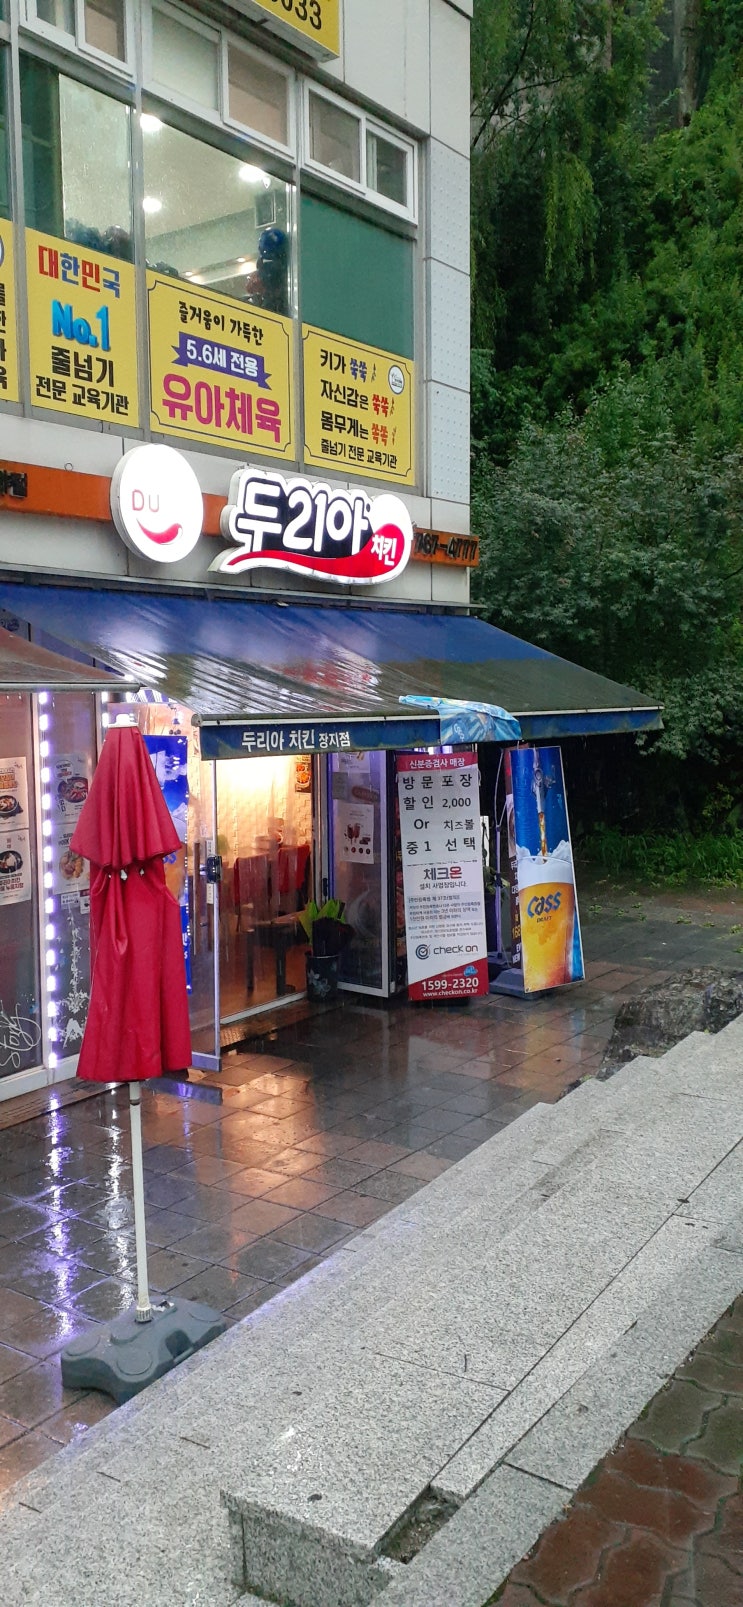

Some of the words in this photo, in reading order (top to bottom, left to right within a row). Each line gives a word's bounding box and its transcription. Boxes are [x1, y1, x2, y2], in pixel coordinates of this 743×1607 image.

[38, 245, 120, 298] 대한민국
[51, 299, 111, 352] No.1
[178, 300, 225, 331] 즐거움이
[230, 319, 264, 346] 가득한
[51, 346, 115, 388] 줄넘기
[186, 339, 226, 369] 5.6세
[230, 352, 258, 378] 전용
[320, 349, 346, 374] 키가
[35, 375, 67, 403] 전문
[72, 383, 129, 416] 교육기관
[162, 373, 282, 443] 유아체육
[320, 379, 369, 411] 자신감은
[321, 410, 369, 440] 몸무게는
[321, 438, 346, 458] 줄넘기
[348, 444, 364, 462] 전문
[367, 449, 397, 469] 교육기관
[371, 532, 397, 566] 치킨
[242, 730, 284, 752] 두리아
[289, 729, 315, 750] 치킨
[319, 731, 351, 749] 장지점
[409, 759, 447, 769] 신분증검사
[450, 757, 465, 767] 매장
[442, 798, 471, 808] 2,000
[413, 819, 429, 830] Or
[443, 819, 474, 831] 치즈볼
[424, 866, 462, 881] 체크온
[421, 977, 479, 991] 1599-2320
[423, 988, 478, 997] www.checkon.co.kr
